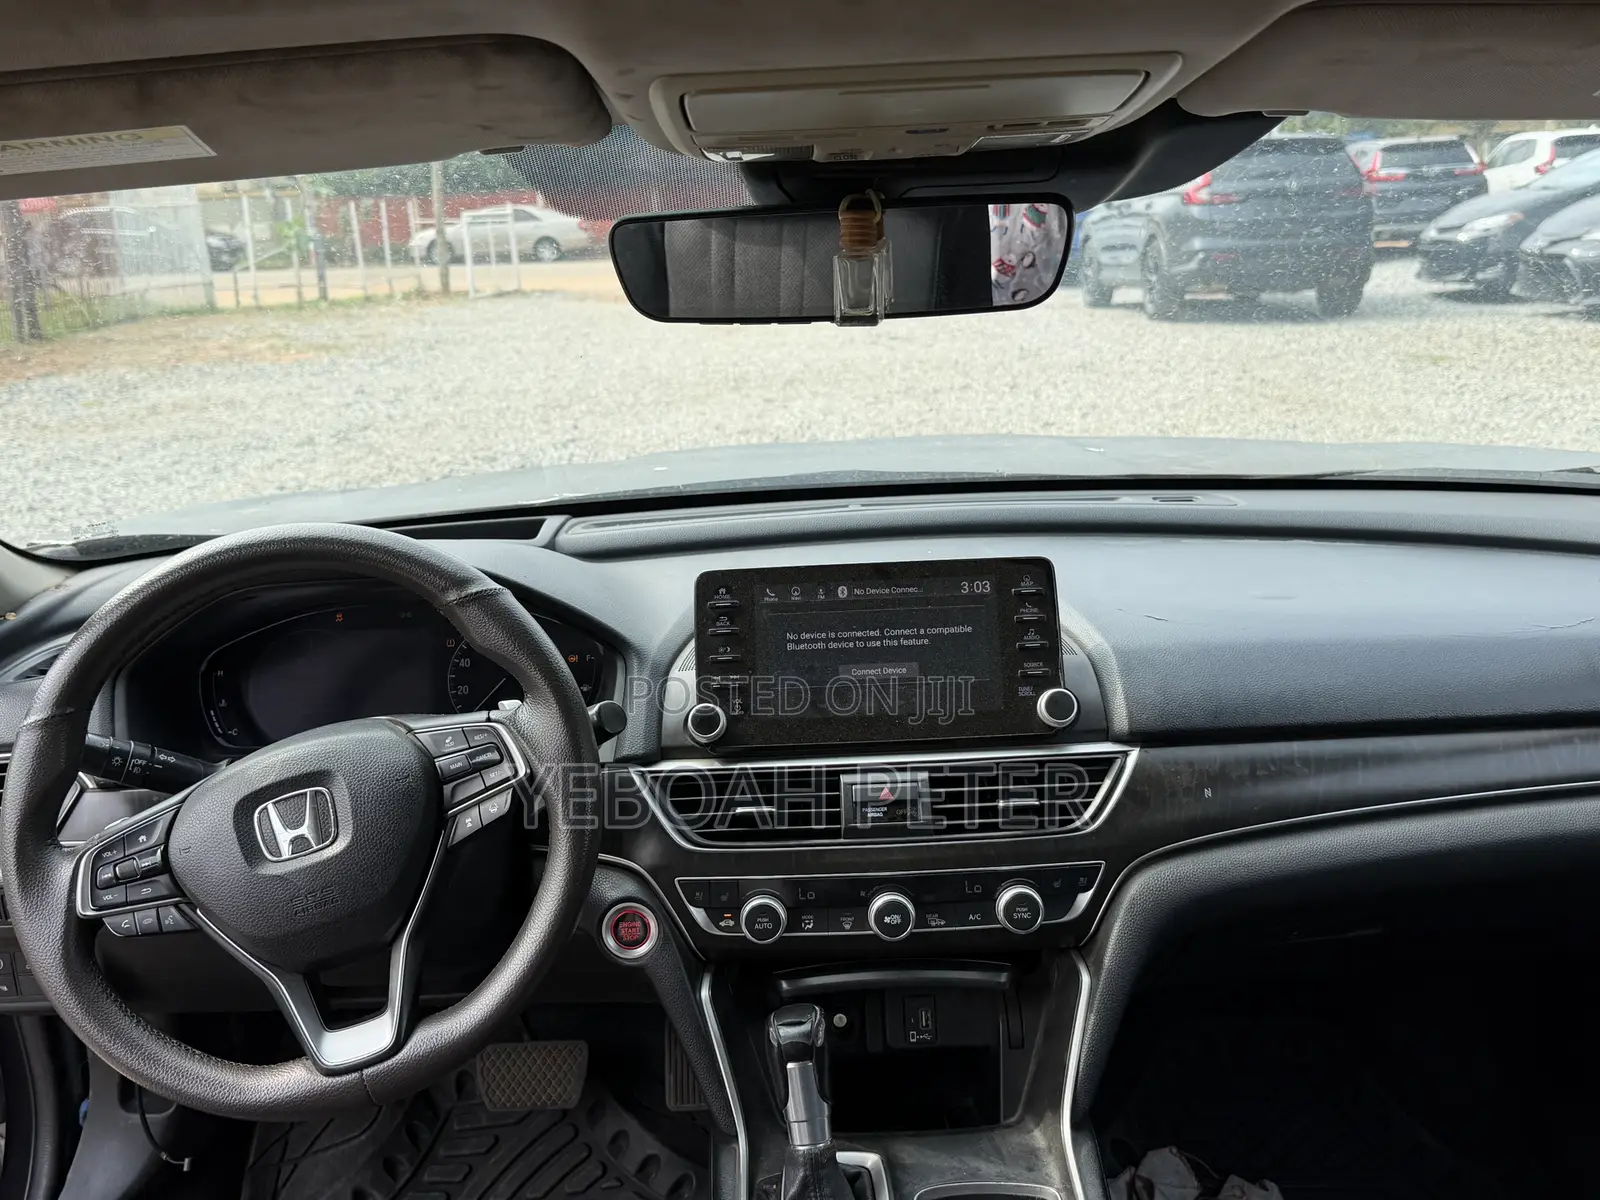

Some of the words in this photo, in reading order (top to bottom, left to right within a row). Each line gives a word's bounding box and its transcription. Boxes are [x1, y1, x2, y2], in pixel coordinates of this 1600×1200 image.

[0, 132, 143, 152] ARNING
[853, 587, 865, 595] No
[865, 586, 890, 595] Device
[960, 580, 991, 594] 3:03
[786, 632, 799, 640] No
[800, 630, 826, 640] device
[828, 630, 836, 639] is
[837, 629, 882, 638] connected.
[884, 627, 918, 637] Connect
[926, 624, 973, 636] compatible
[786, 641, 827, 651] Bluetooth
[828, 640, 854, 650] device
[855, 640, 865, 648] to
[883, 638, 899, 647] this
[900, 637, 932, 646] feature.
[459, 658, 471, 668] 40
[851, 667, 882, 676] Connect
[883, 666, 907, 675] Device
[457, 685, 469, 695] 20
[475, 752, 493, 761] CANCEL
[134, 758, 147, 766] OFF
[449, 762, 463, 770] MAIN
